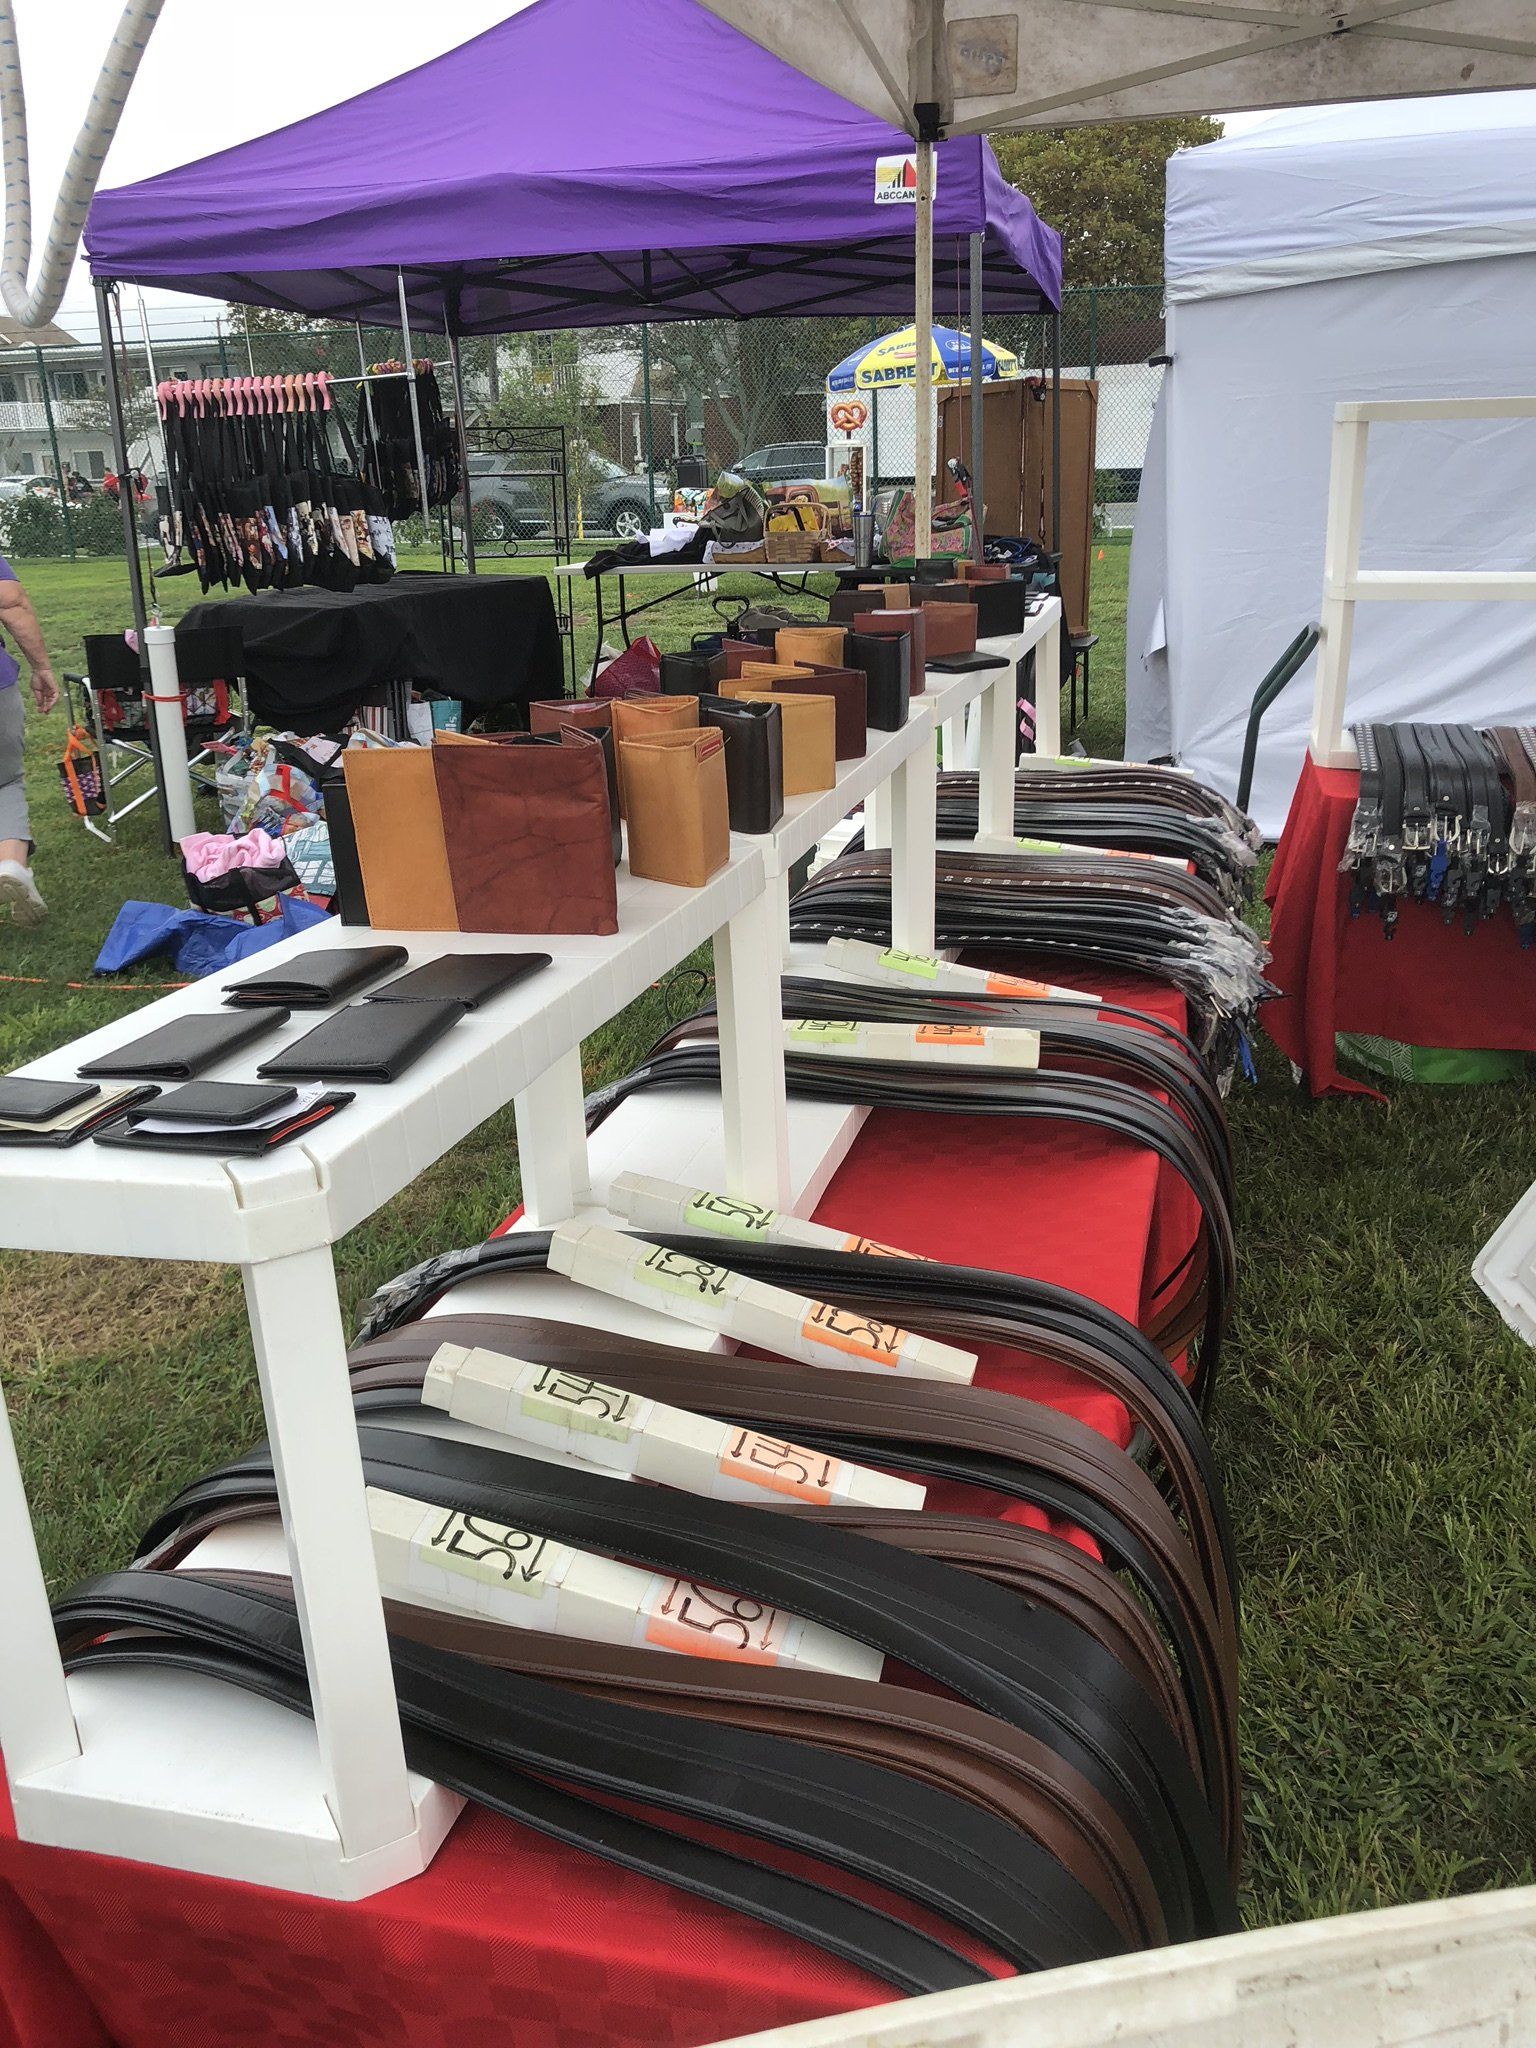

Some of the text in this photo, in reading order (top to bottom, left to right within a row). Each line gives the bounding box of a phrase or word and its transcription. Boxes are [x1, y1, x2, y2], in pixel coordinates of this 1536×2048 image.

[877, 190, 932, 200] ABCCAN
[861, 363, 939, 384] SABRET
[705, 1196, 764, 1229] 50
[547, 1372, 621, 1419] 54
[750, 1436, 815, 1484] 54
[446, 1515, 533, 1581] 56
[677, 1583, 764, 1650] 56
